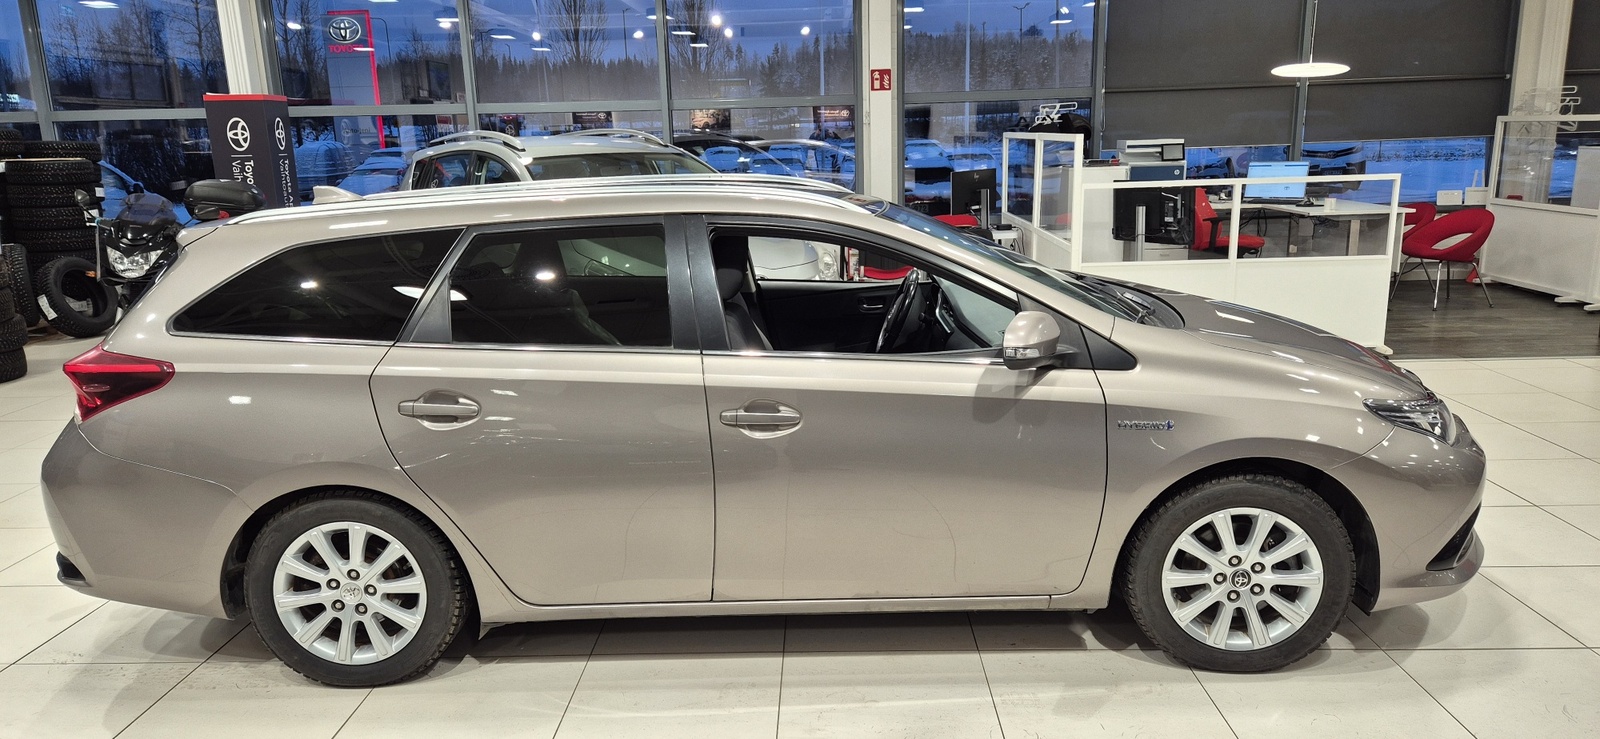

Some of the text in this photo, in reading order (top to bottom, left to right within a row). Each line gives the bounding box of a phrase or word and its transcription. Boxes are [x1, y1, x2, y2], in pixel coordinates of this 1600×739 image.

[232, 160, 243, 182] Vaih
[244, 160, 255, 186] Toyo
[279, 159, 289, 208] Vaihtoaut
